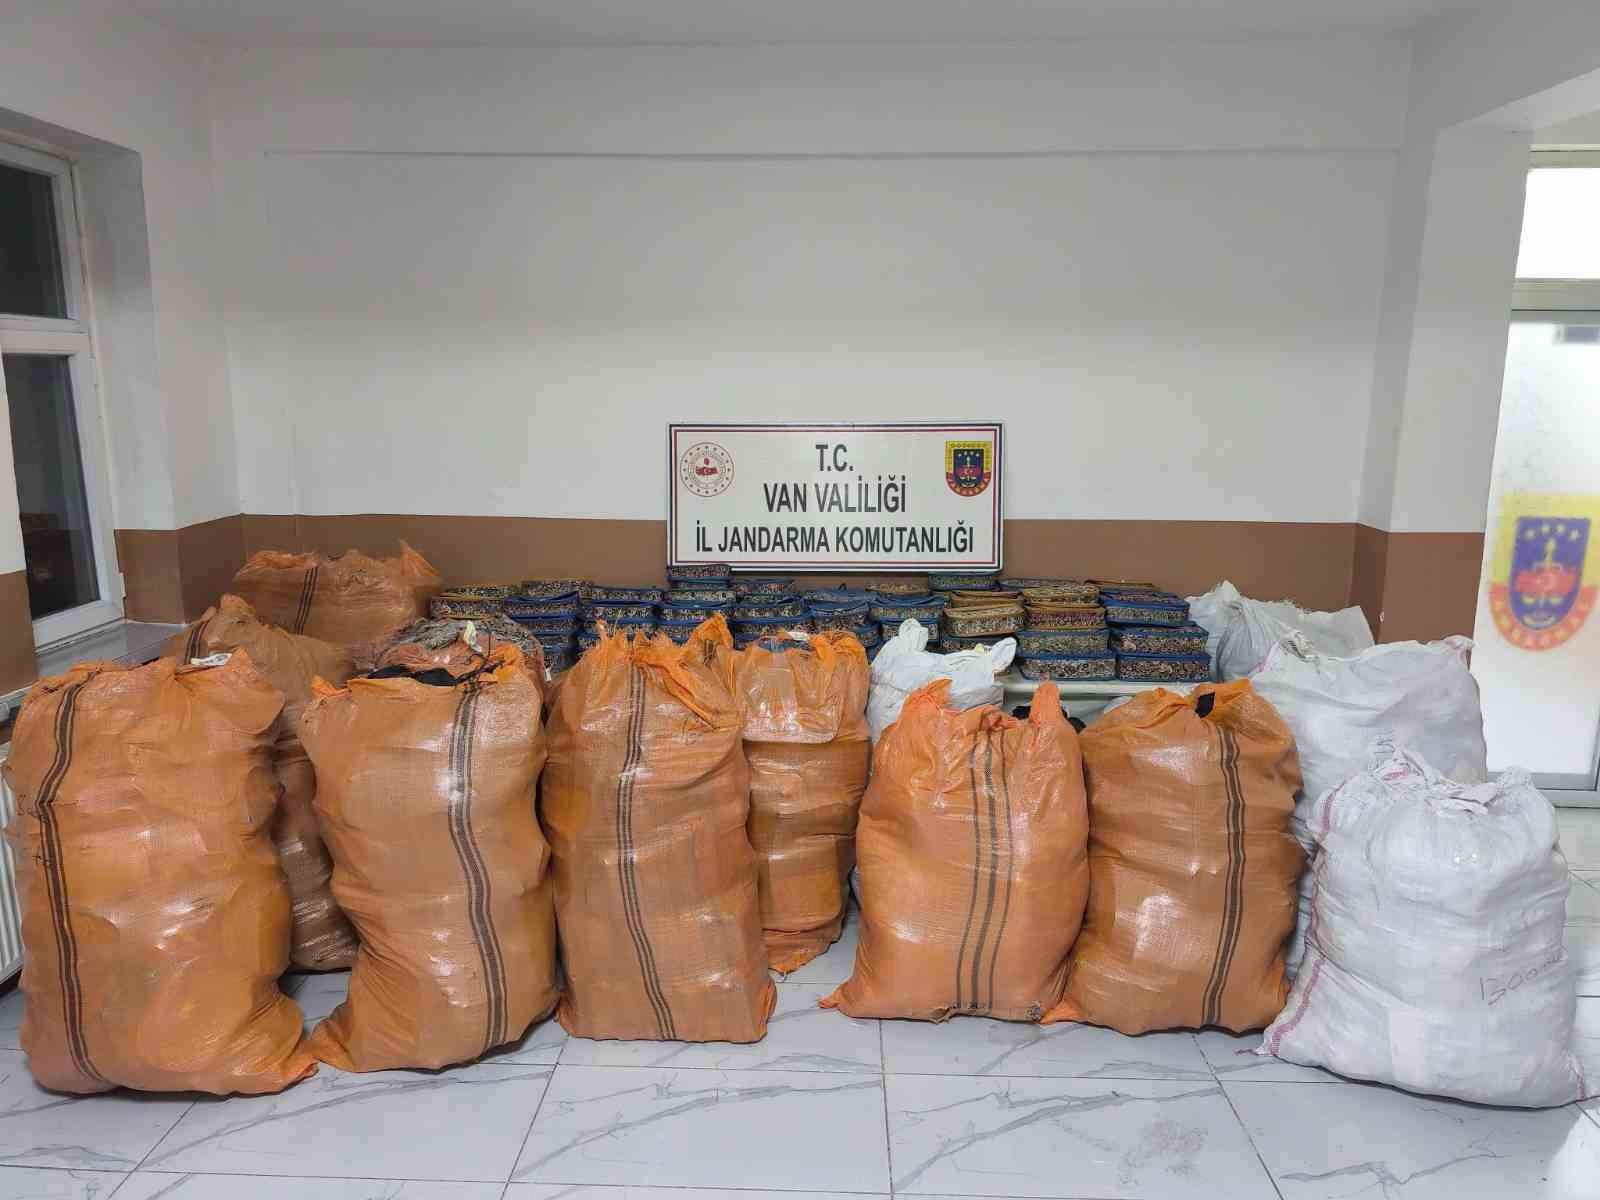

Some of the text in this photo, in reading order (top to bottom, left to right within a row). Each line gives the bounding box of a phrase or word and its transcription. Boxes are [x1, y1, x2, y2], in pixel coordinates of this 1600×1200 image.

[815, 444, 854, 472] T.C.
[763, 482, 807, 513] VAN
[814, 475, 906, 513] VALİLİĞİ
[696, 520, 974, 553] İL JANDARMA KOMUTANLIĞI
